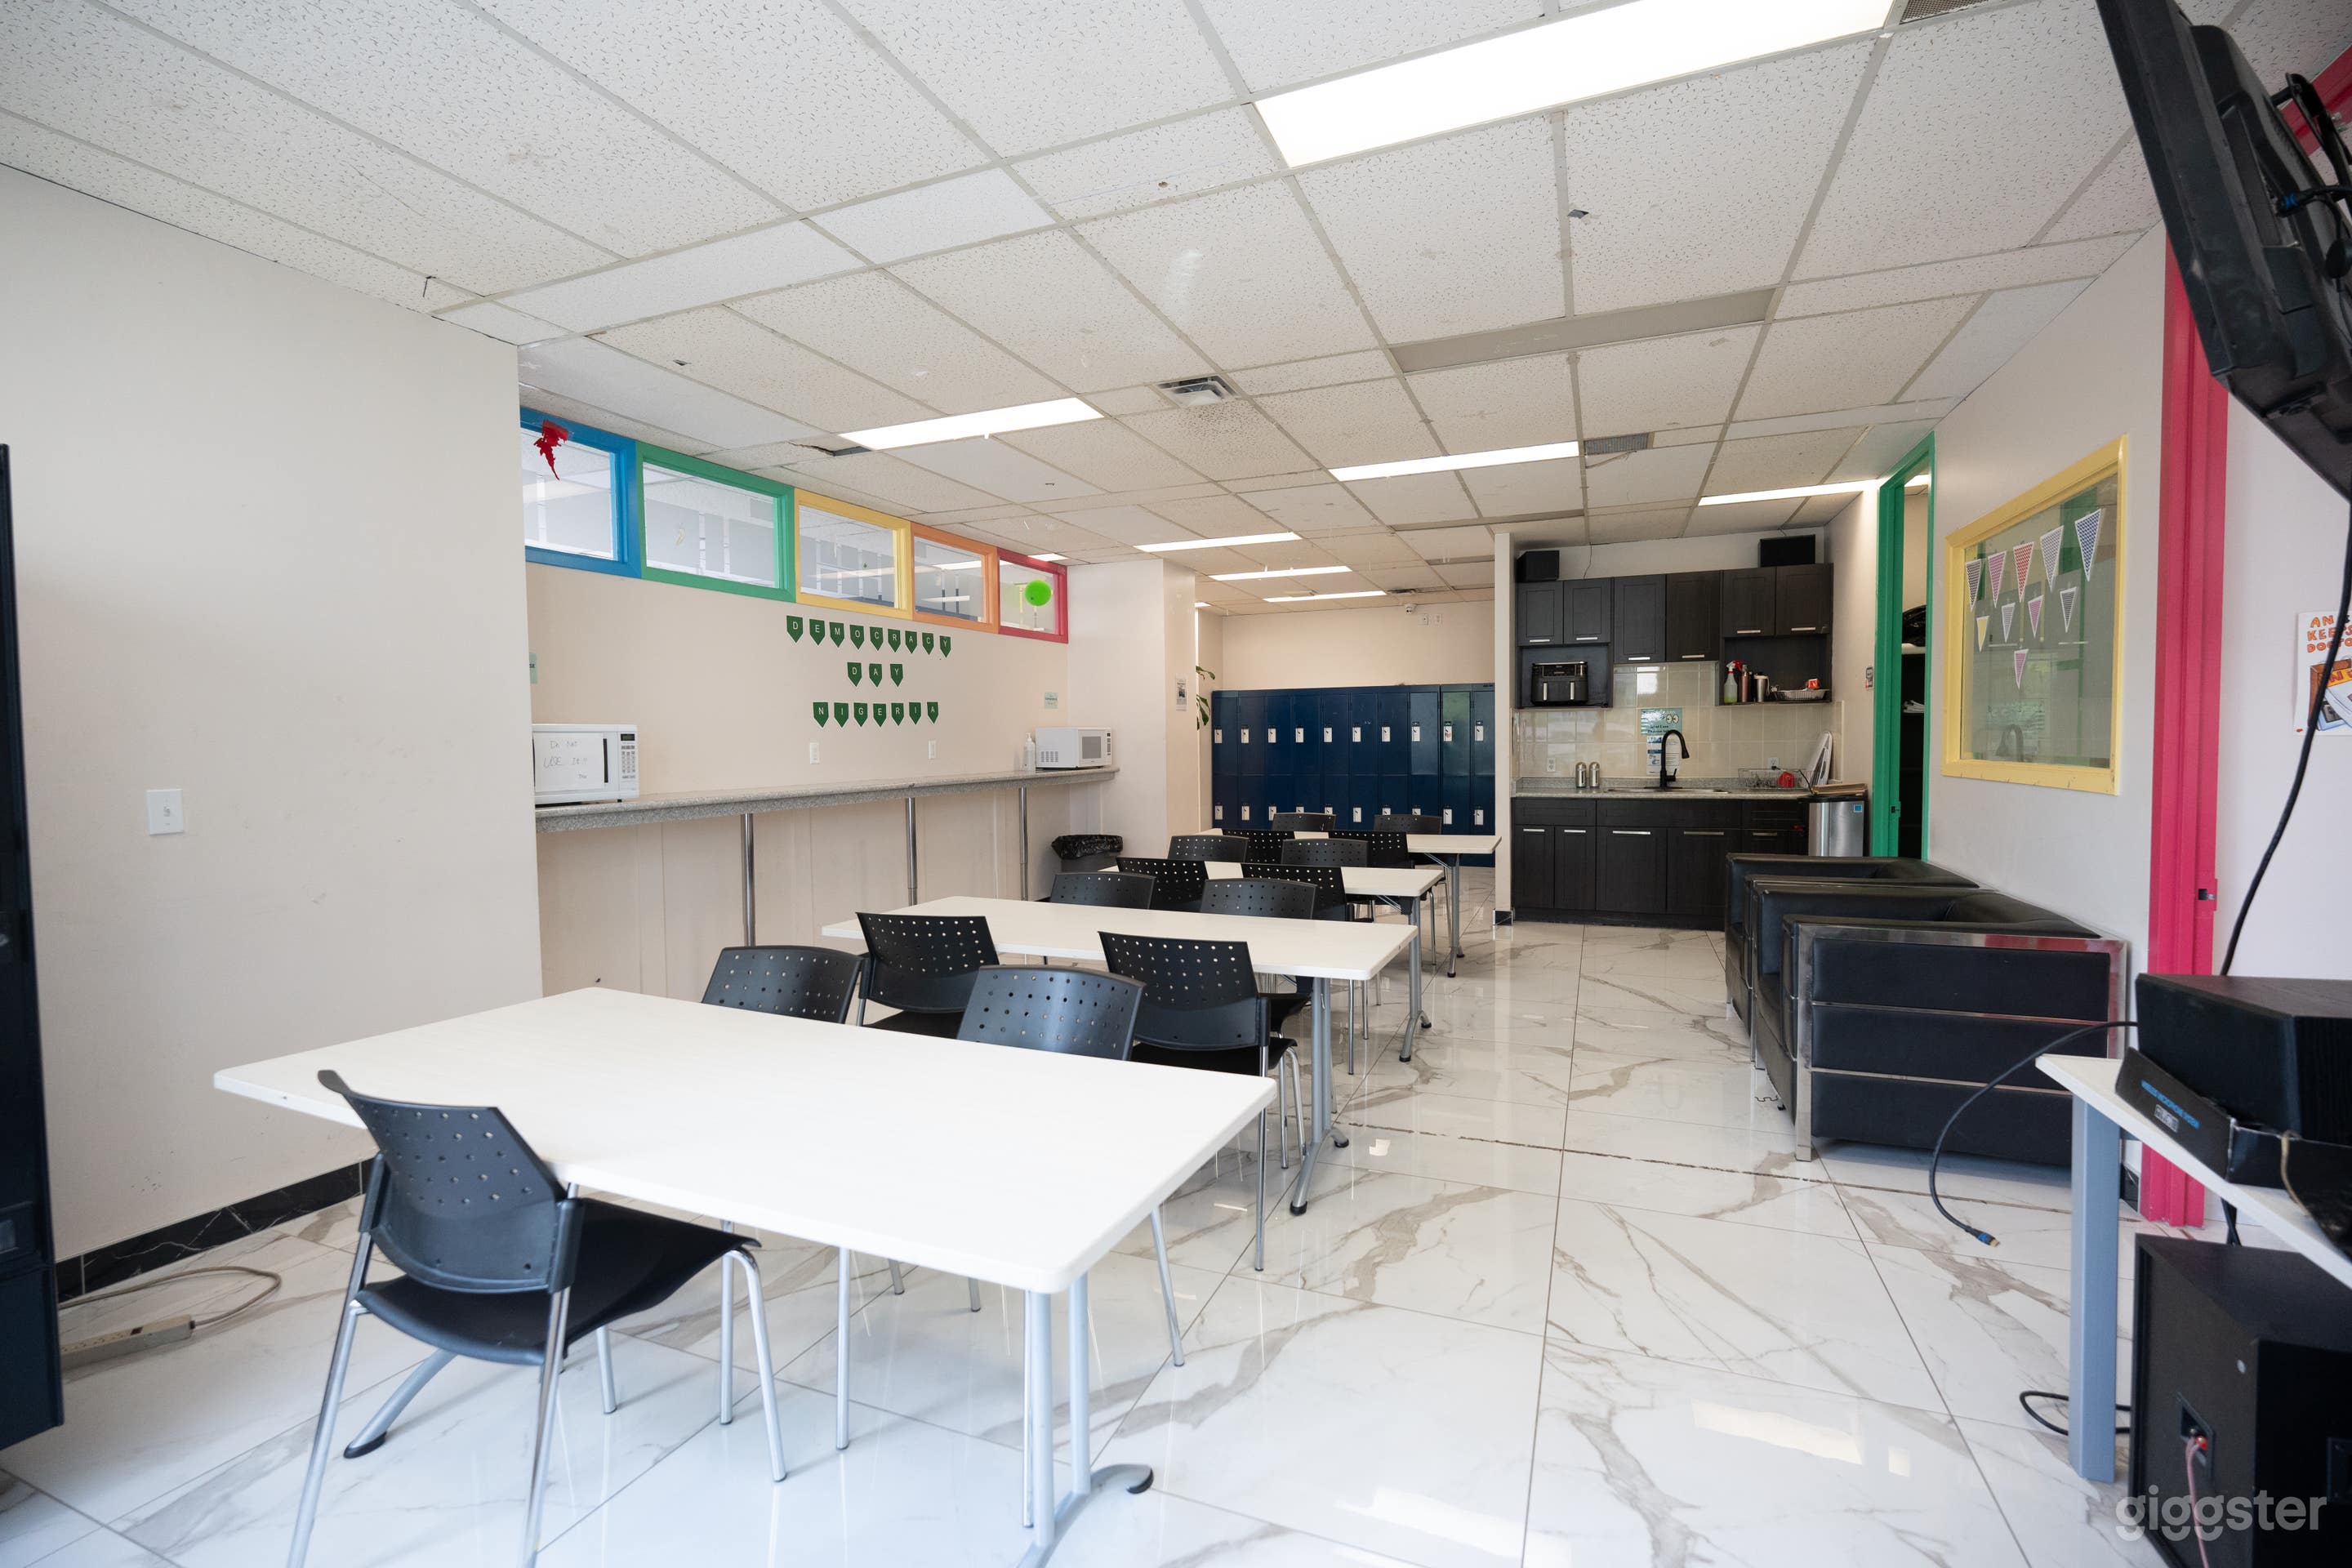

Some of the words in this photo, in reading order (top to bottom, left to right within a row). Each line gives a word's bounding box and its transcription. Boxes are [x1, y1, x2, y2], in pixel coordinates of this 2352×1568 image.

[2310, 615, 2334, 628] AN
[793, 621, 947, 648] DEMOCRACY
[2307, 624, 2352, 641] KEES
[852, 666, 899, 676] DAY
[818, 706, 935, 716] NIGERIA
